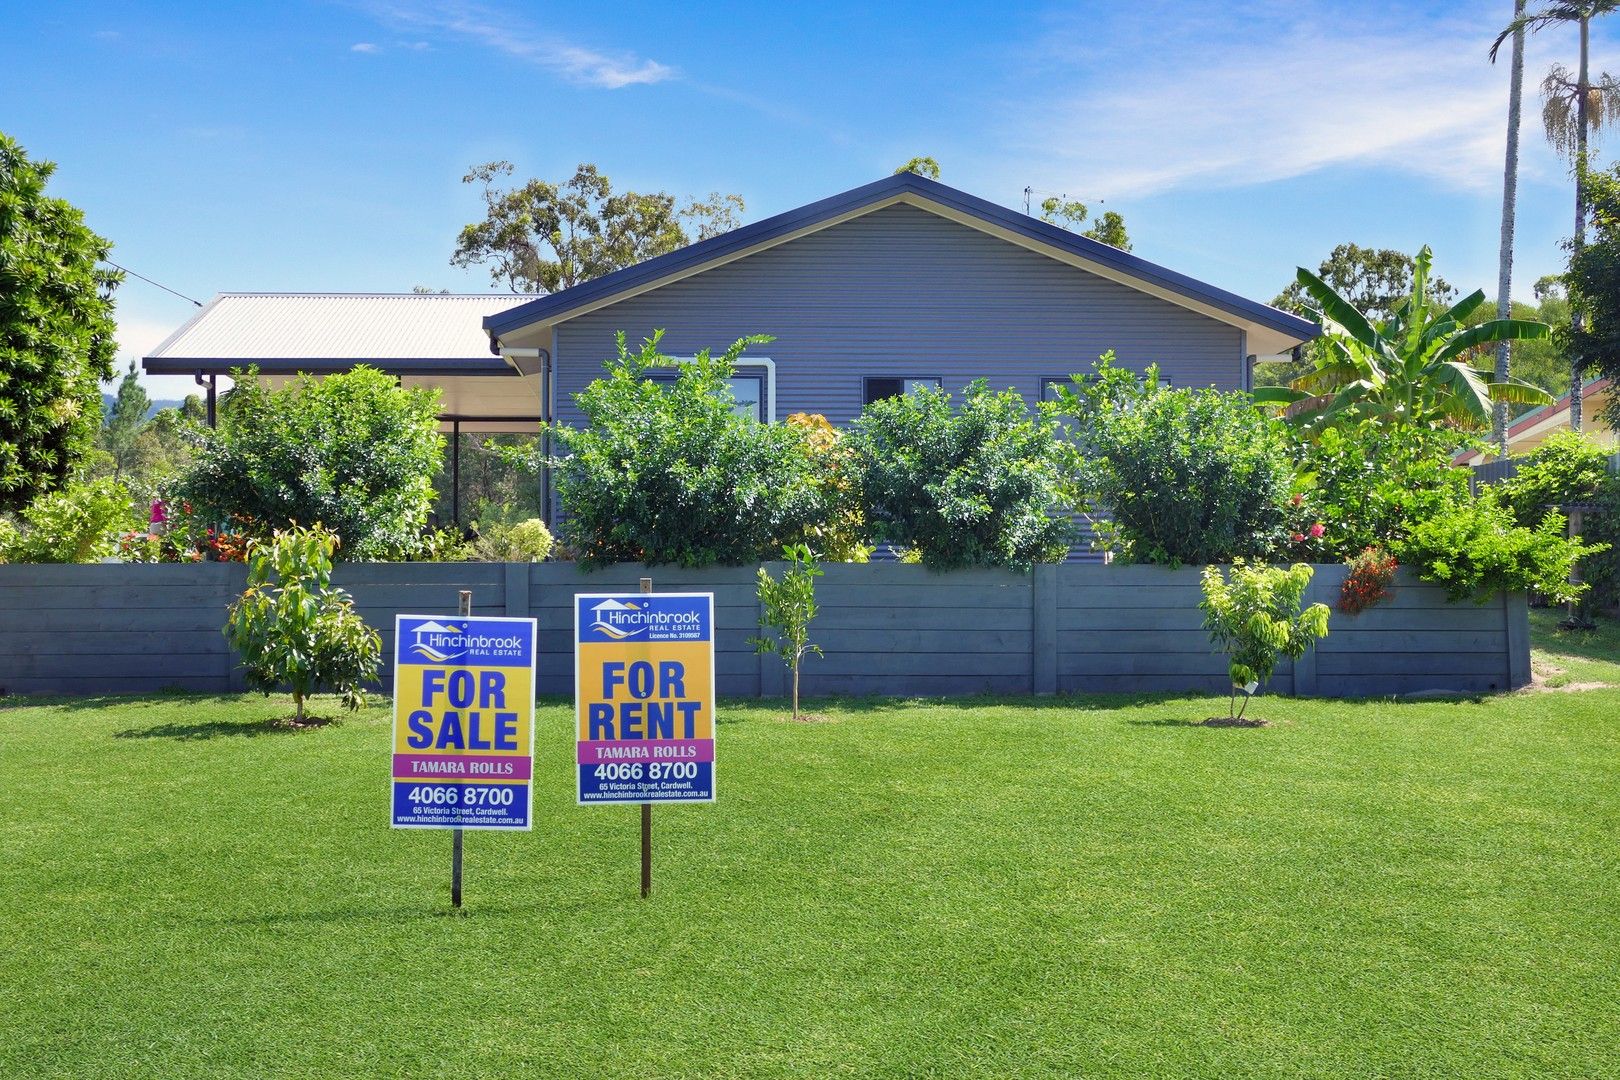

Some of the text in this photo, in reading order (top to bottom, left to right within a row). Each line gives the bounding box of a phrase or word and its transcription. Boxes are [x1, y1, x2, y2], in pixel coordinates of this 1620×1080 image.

[609, 611, 700, 624] Hinchinbrook
[429, 633, 522, 649] Hinchinbrook
[493, 649, 522, 657] ESTATE
[602, 660, 686, 699] FOR
[421, 669, 506, 709] FOR
[588, 701, 701, 740] RENT
[407, 710, 518, 750] SALE
[595, 745, 697, 759] TAMARA ROLLS
[411, 761, 513, 775] TAMARA ROLLS
[594, 761, 698, 780] 4066 8700
[599, 781, 693, 791] 65 Victoria Street, Cardwell.
[408, 786, 514, 806] 4066 8700
[584, 790, 708, 799] www.hinchinbrookrealestate.com.au
[412, 806, 508, 816] 65 Victoria Street, Cardwell.
